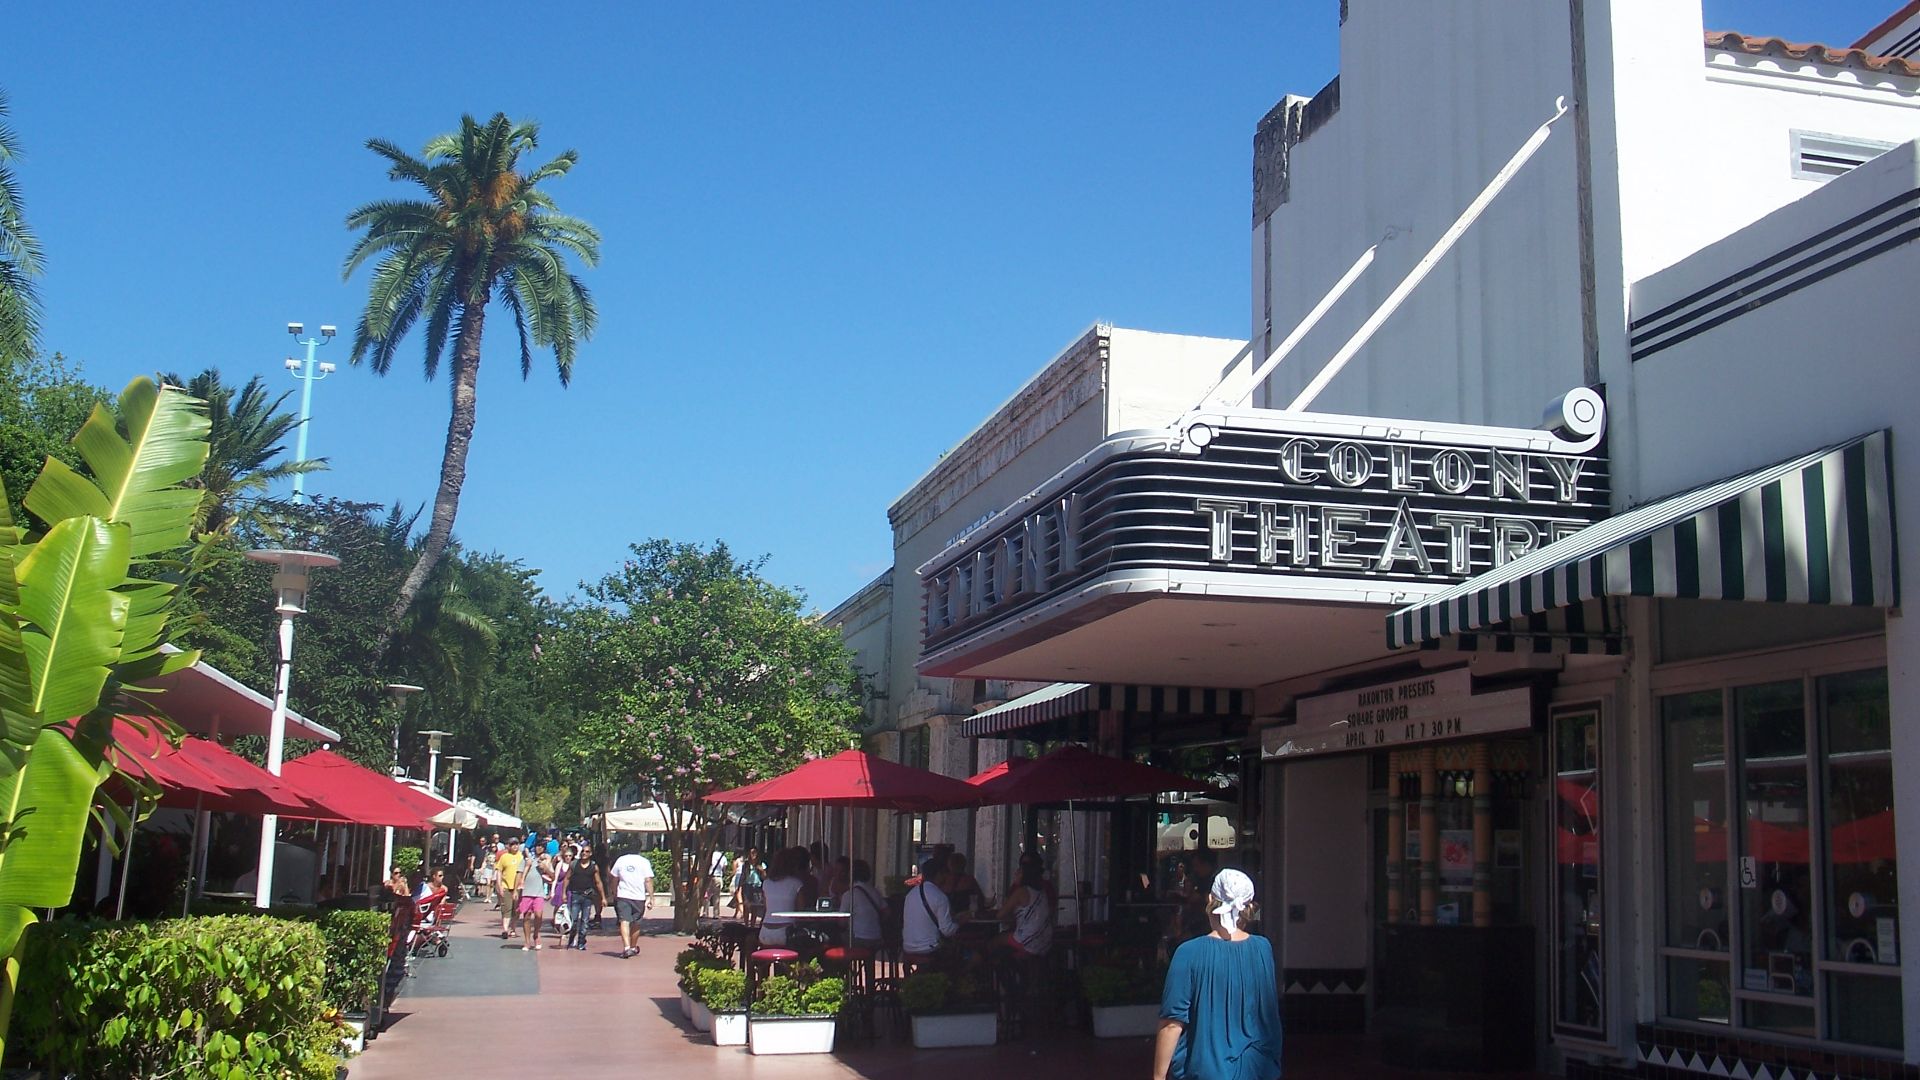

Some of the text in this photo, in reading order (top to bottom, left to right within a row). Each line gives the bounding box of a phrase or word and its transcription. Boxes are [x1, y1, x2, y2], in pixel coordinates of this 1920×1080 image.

[1279, 437, 1587, 504] COLONY
[1399, 681, 1435, 699] PRESENTS
[1347, 706, 1408, 728] SQUARE GROUPER
[1346, 731, 1365, 747] APRIL
[1375, 729, 1384, 743] 20
[1405, 724, 1414, 740] AT
[1420, 723, 1425, 737] 7
[1431, 720, 1443, 737] 30
